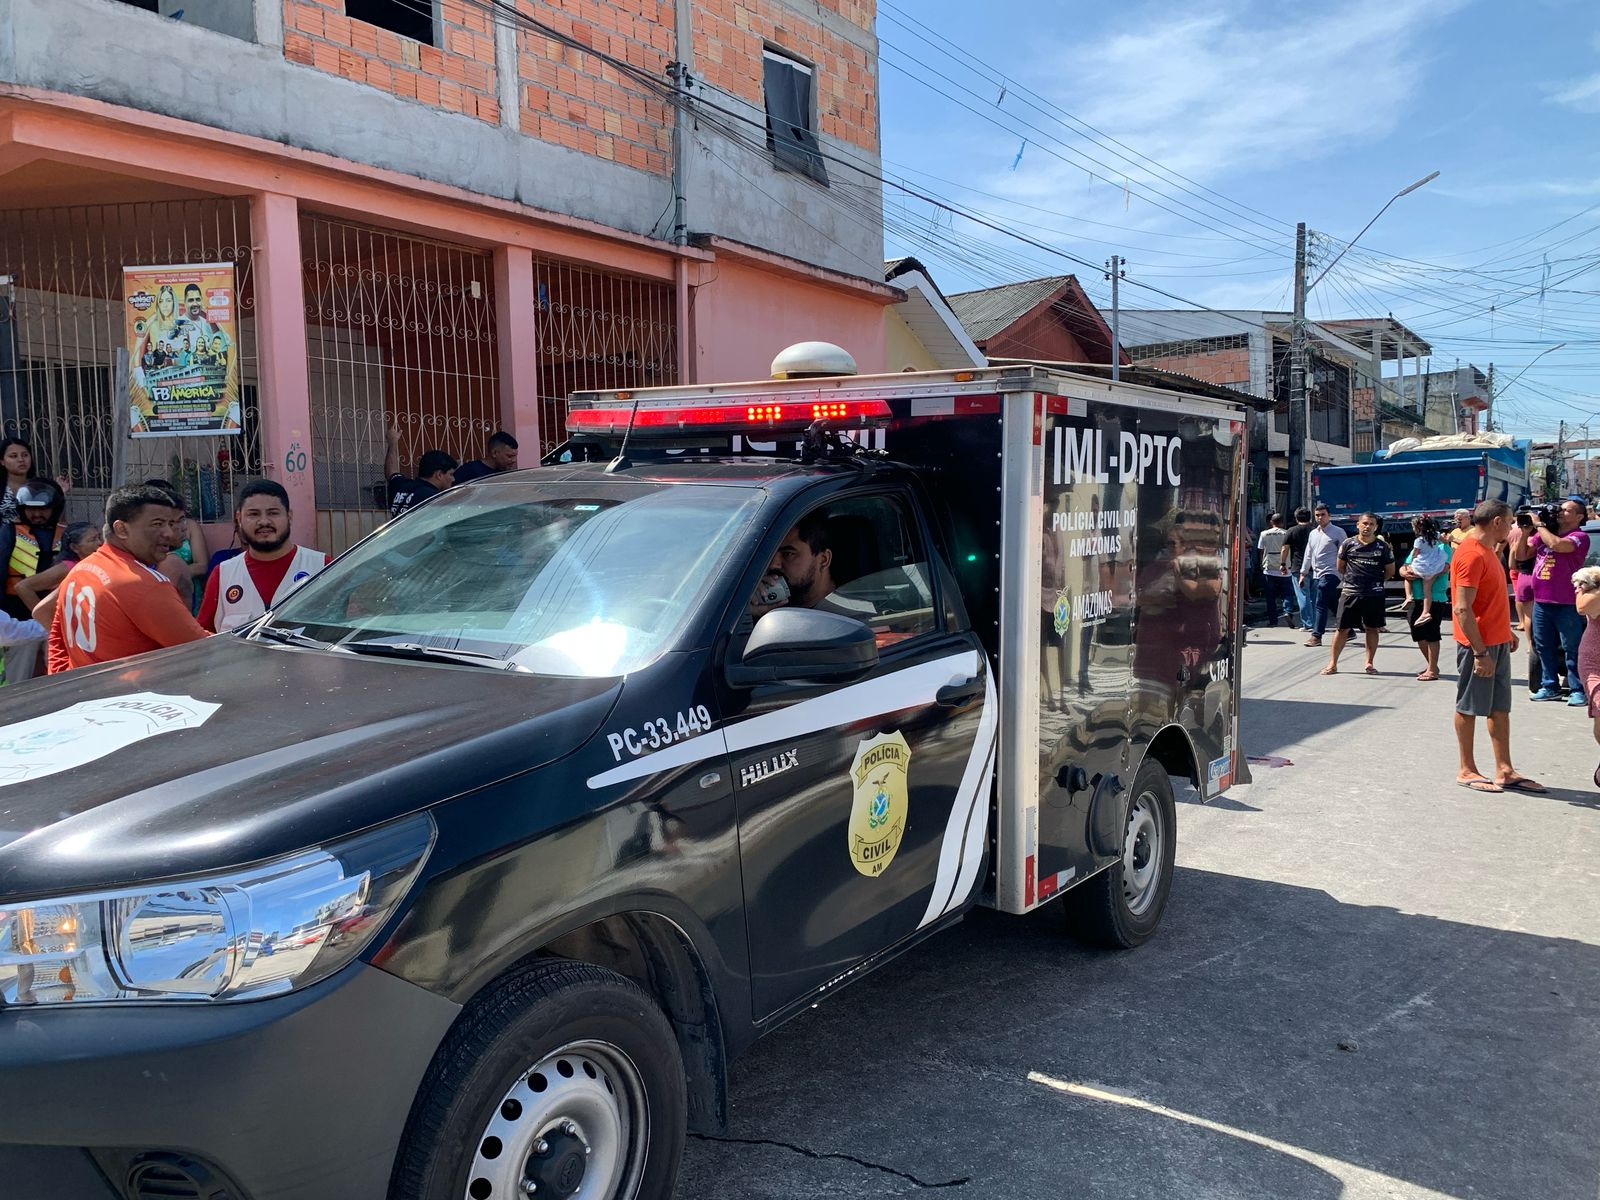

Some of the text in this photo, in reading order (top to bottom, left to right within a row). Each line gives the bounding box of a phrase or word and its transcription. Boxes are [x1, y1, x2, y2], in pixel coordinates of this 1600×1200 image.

[152, 387, 170, 401] FB
[285, 451, 307, 473] 60
[1053, 426, 1182, 487] IML-DPTC
[1052, 505, 1136, 532] POLÍCIA CIVIL DO
[1069, 534, 1122, 558] AMAZONAS
[65, 581, 97, 653] 10
[1072, 589, 1113, 621] AMAZONAS
[606, 704, 712, 762] PC-33.449
[740, 748, 800, 788] HILUX
[863, 745, 900, 770] POLÍCIA
[863, 838, 891, 860] CIVIL
[872, 863, 883, 875] AM
